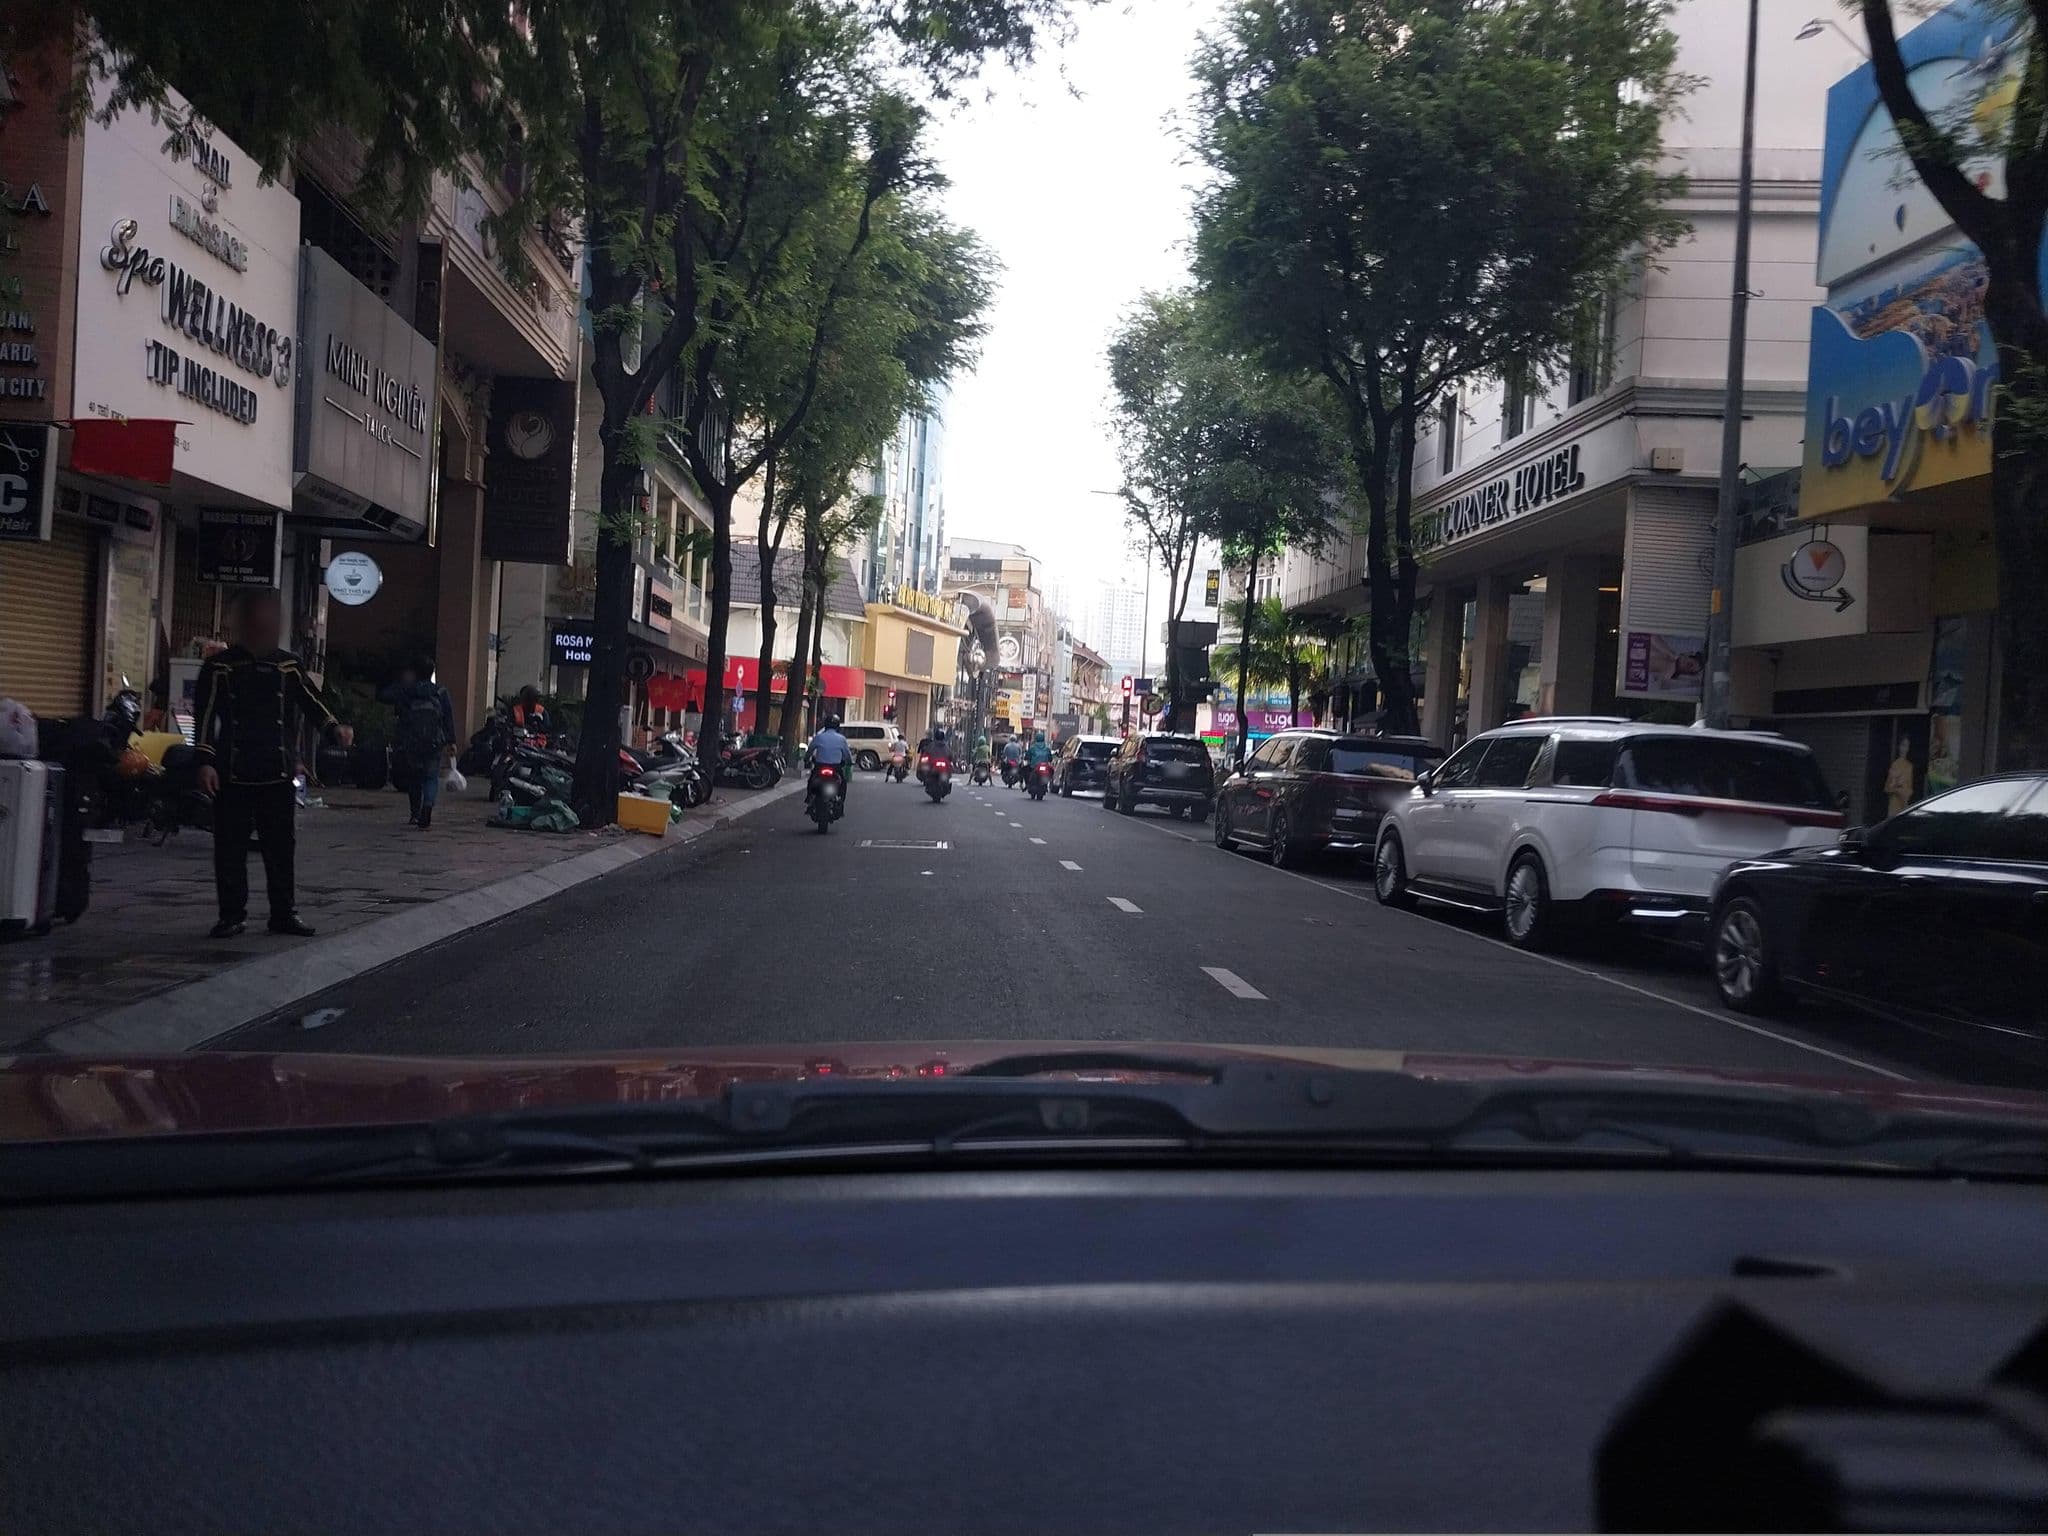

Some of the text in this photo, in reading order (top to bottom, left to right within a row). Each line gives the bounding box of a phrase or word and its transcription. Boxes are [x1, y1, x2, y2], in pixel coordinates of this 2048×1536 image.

[100, 218, 166, 296] Spa
[169, 193, 249, 273] MASSAGE
[161, 261, 292, 388] WELLNESS 3
[145, 337, 259, 425] TIP INCLUDED
[326, 333, 372, 396] MINH
[1441, 479, 1509, 541] CORNER
[1512, 445, 1583, 516] HOTEL
[556, 634, 583, 648] ROSA
[1217, 712, 1235, 726] tugo
